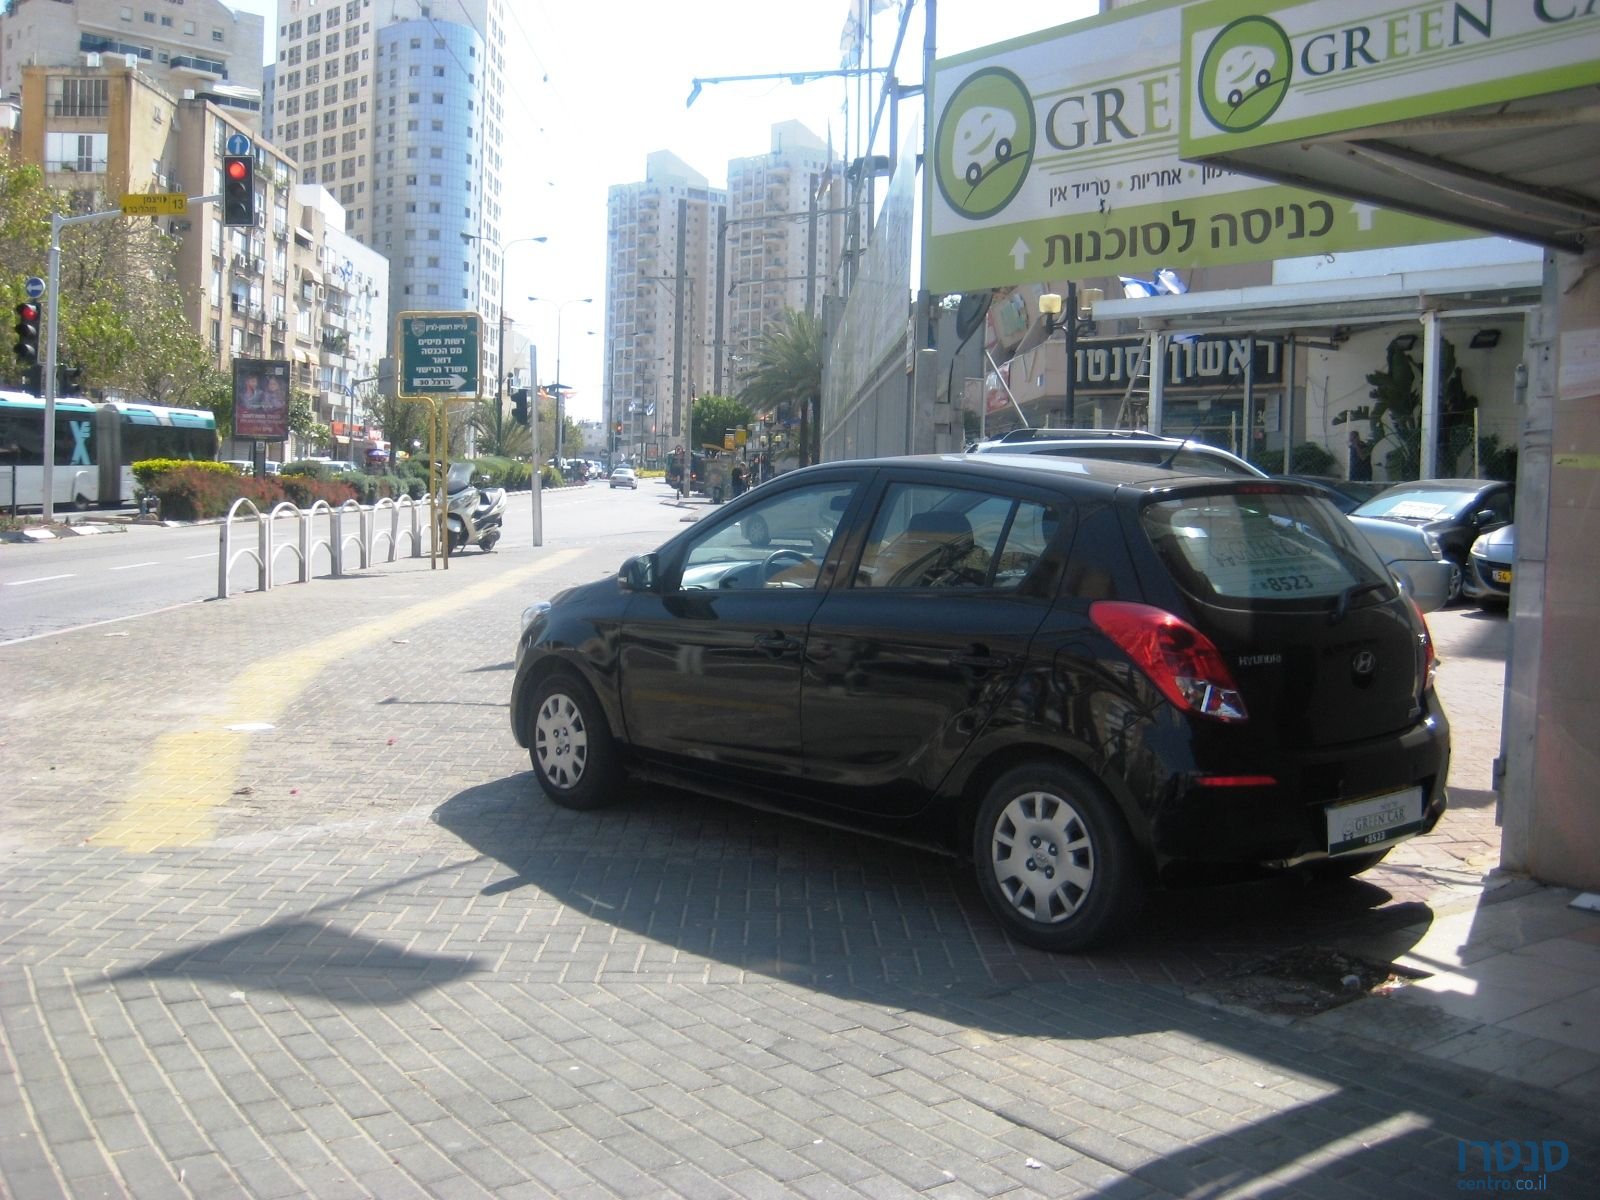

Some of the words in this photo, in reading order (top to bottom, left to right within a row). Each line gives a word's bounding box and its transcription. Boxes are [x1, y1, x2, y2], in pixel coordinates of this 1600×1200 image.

[1301, 0, 1493, 76] GREEN
[1533, 0, 1600, 24] C
[1046, 74, 1177, 150] GRE
[1072, 178, 1111, 199] טרייד
[1129, 168, 1182, 192] אחריות
[174, 199, 184, 210] 13
[1049, 186, 1068, 208] אין
[1210, 200, 1335, 249] כניסה
[1042, 210, 1196, 268] לסוכנות
[421, 347, 448, 355] הכנסה
[1169, 339, 1276, 384] ראשון
[416, 366, 442, 374] הרישוי
[1239, 653, 1282, 666] HYUNDAI
[1355, 813, 1385, 831] GREEN
[1387, 808, 1406, 822] CAR
